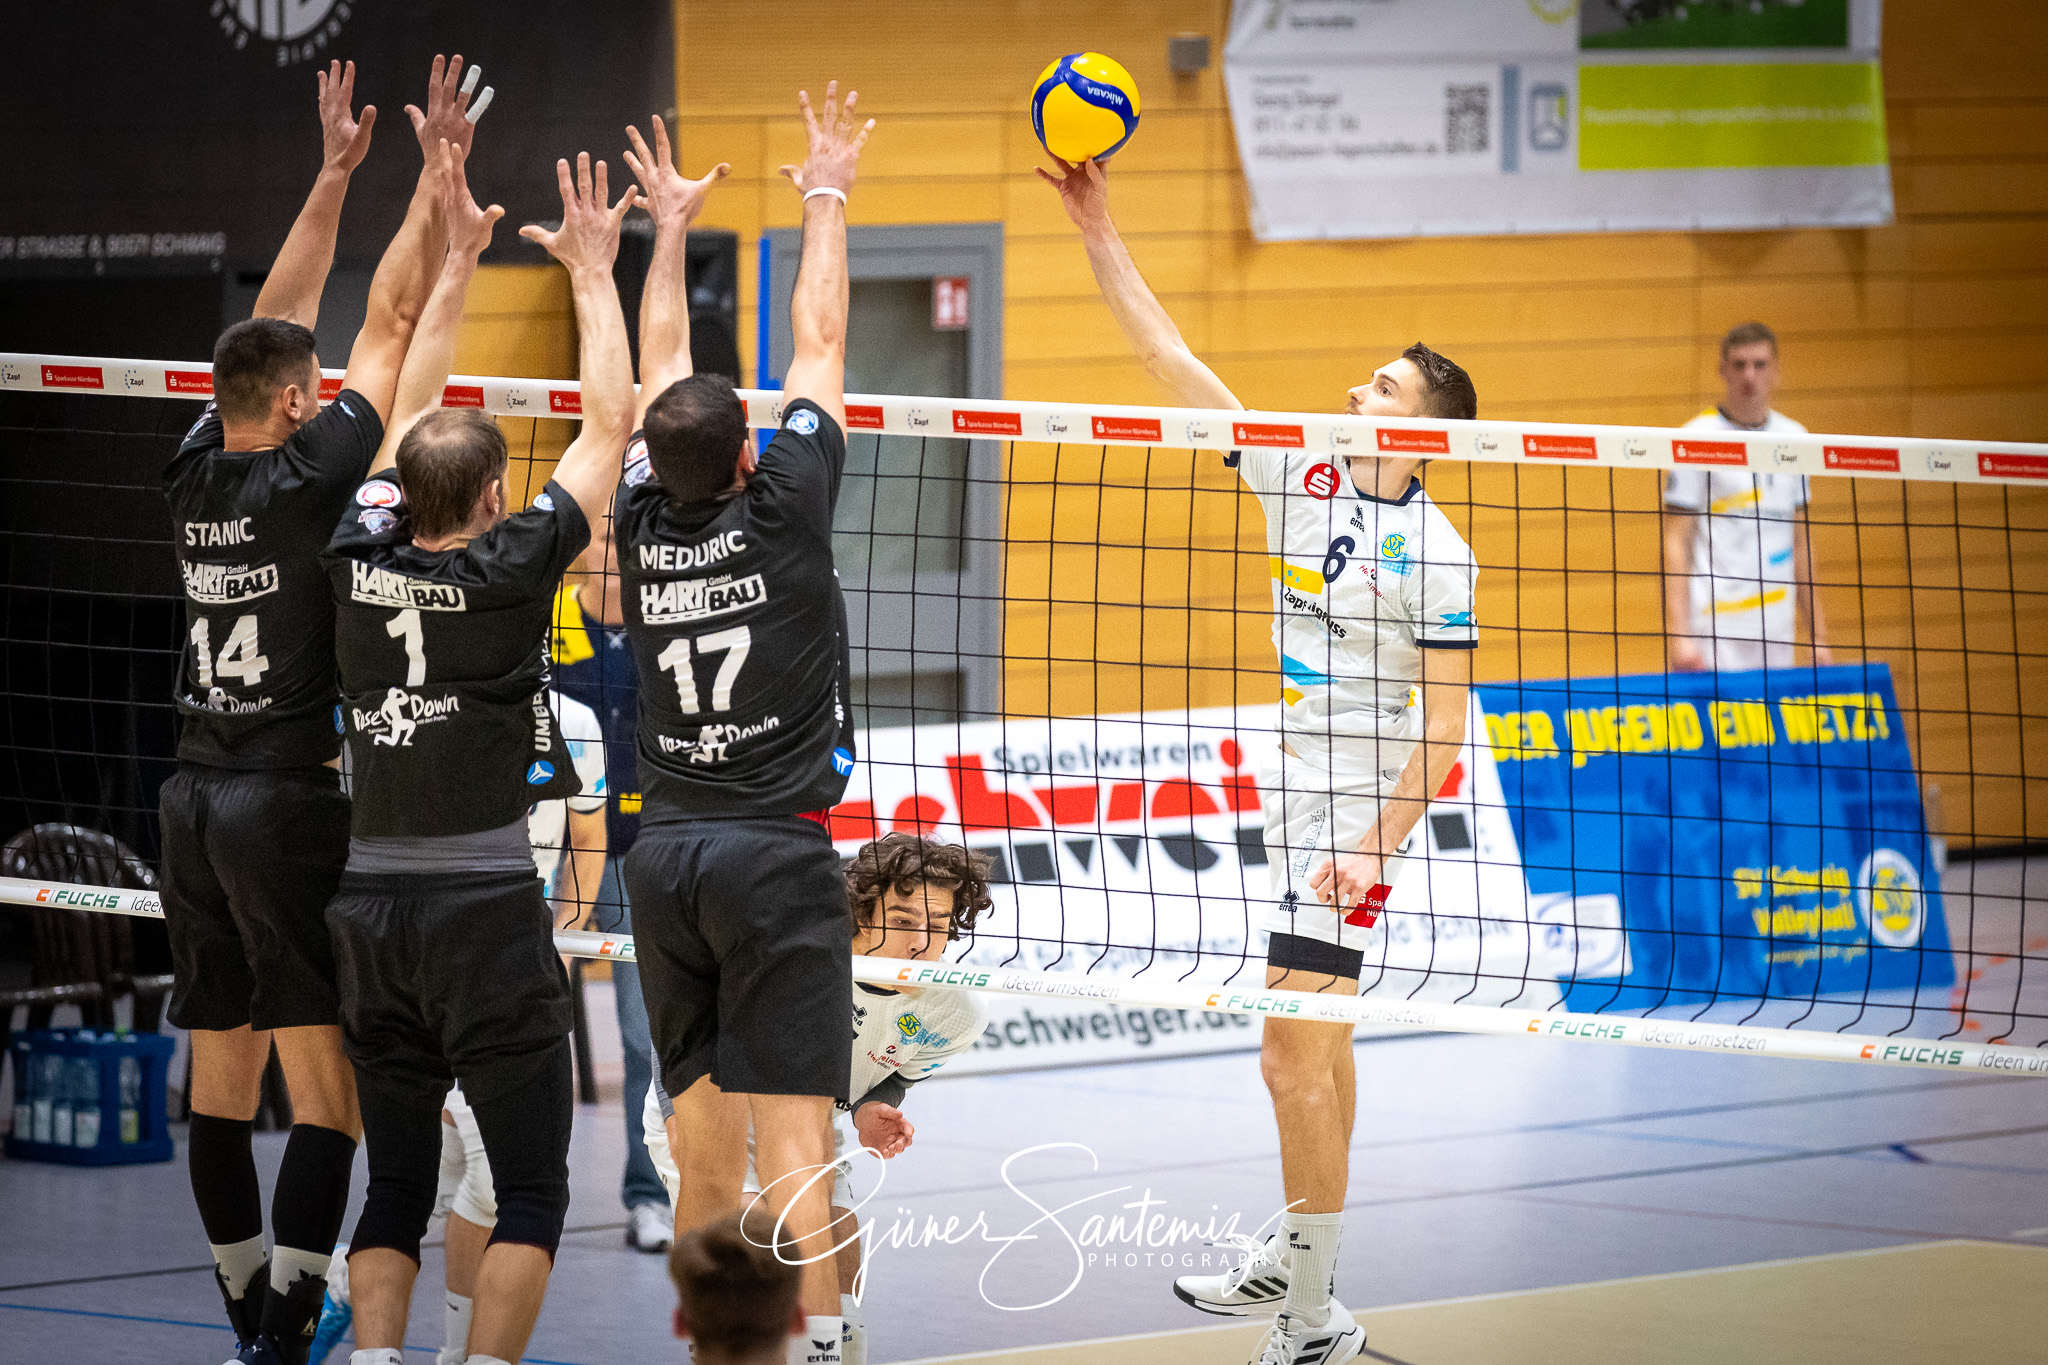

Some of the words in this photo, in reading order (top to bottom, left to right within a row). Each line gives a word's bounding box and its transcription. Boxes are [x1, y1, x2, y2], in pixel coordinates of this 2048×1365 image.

[6, 373, 20, 381] Zapf
[130, 378, 144, 386] Zapf
[512, 398, 527, 406] Zapf
[913, 417, 929, 426] Zapf
[1052, 424, 1067, 433] Zapf
[1193, 431, 1208, 439] Zapf
[185, 517, 255, 547] STANIC
[639, 530, 747, 571] MEDURIC
[1322, 535, 1356, 584] 6
[182, 560, 226, 595] HART
[226, 570, 276, 599] BAU
[227, 564, 248, 575] GmbH
[352, 559, 408, 601] HART
[412, 587, 460, 608] BAU
[708, 573, 732, 587] GmbH
[640, 578, 708, 614] HART
[709, 580, 761, 612] BAU
[190, 615, 269, 688] 14
[386, 608, 426, 686] 1
[657, 625, 752, 714] 17
[352, 707, 382, 732] Pose
[410, 693, 460, 720] Down
[1487, 710, 1560, 762] DER
[1564, 702, 1704, 768] JUGEND
[1708, 698, 1776, 749] EIN
[1779, 692, 1891, 744] NETZ!
[993, 740, 1213, 781] Spielwaren
[54, 891, 120, 909] FUCHS
[917, 969, 991, 987] FUCHS
[1002, 975, 1043, 993] Ideen
[1049, 981, 1121, 999] umsetzen
[1227, 995, 1302, 1013] FUCHS
[1315, 1001, 1358, 1017] Ideen
[1361, 1008, 1438, 1025] umsetzen
[1549, 1020, 1627, 1039] FUCHS
[1640, 1026, 1684, 1044] Ideen
[1689, 1031, 1768, 1050] umsetzen
[1883, 1046, 1965, 1065] FUCHS
[1979, 1051, 2024, 1070] Ideen
[807, 1353, 840, 1363] erima
